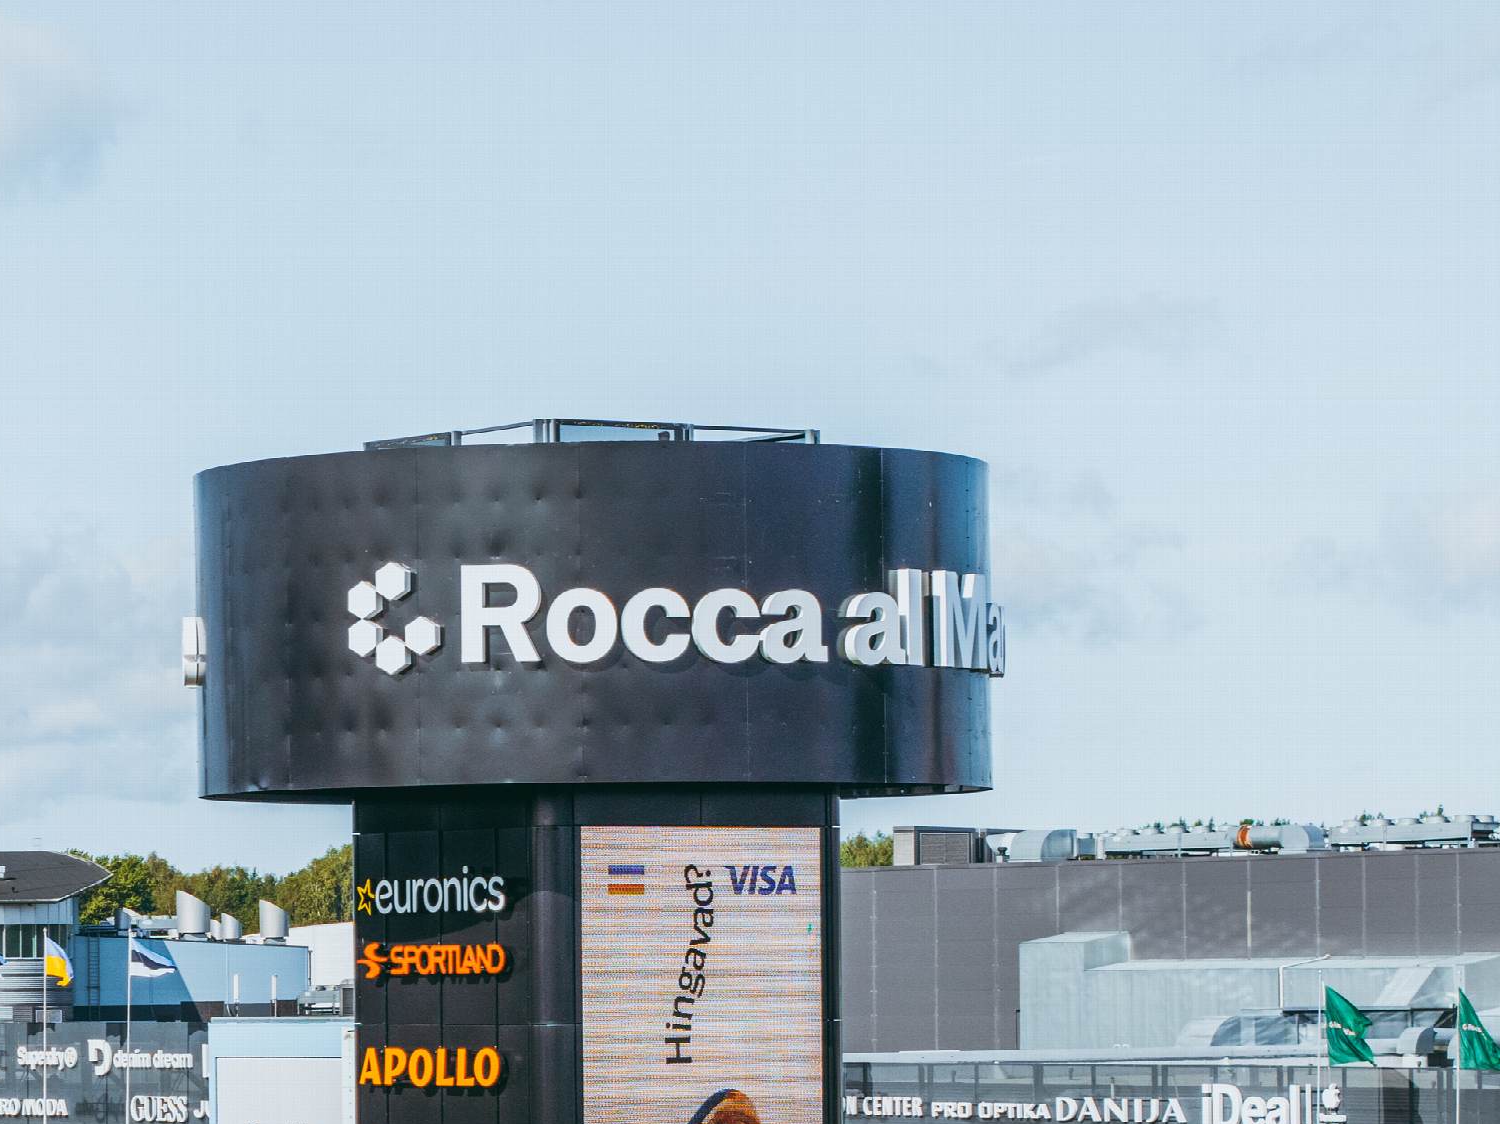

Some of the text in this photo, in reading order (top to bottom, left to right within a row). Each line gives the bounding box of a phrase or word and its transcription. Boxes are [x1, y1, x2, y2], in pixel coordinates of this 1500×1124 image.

[460, 564, 1005, 678] Rocca al Ma
[375, 866, 505, 914] euronics
[724, 865, 797, 895] VISA
[389, 944, 507, 975] SPORTLAND
[665, 864, 714, 1064] Hingavad?
[153, 1049, 193, 1068] dream
[359, 1047, 501, 1087] APOLLO
[22, 1098, 69, 1116] MODA
[130, 1095, 188, 1123] GUESS
[863, 1096, 923, 1116] CENTER
[931, 1101, 1051, 1120] PRO OPTIKA
[1055, 1097, 1187, 1123] DANIJA
